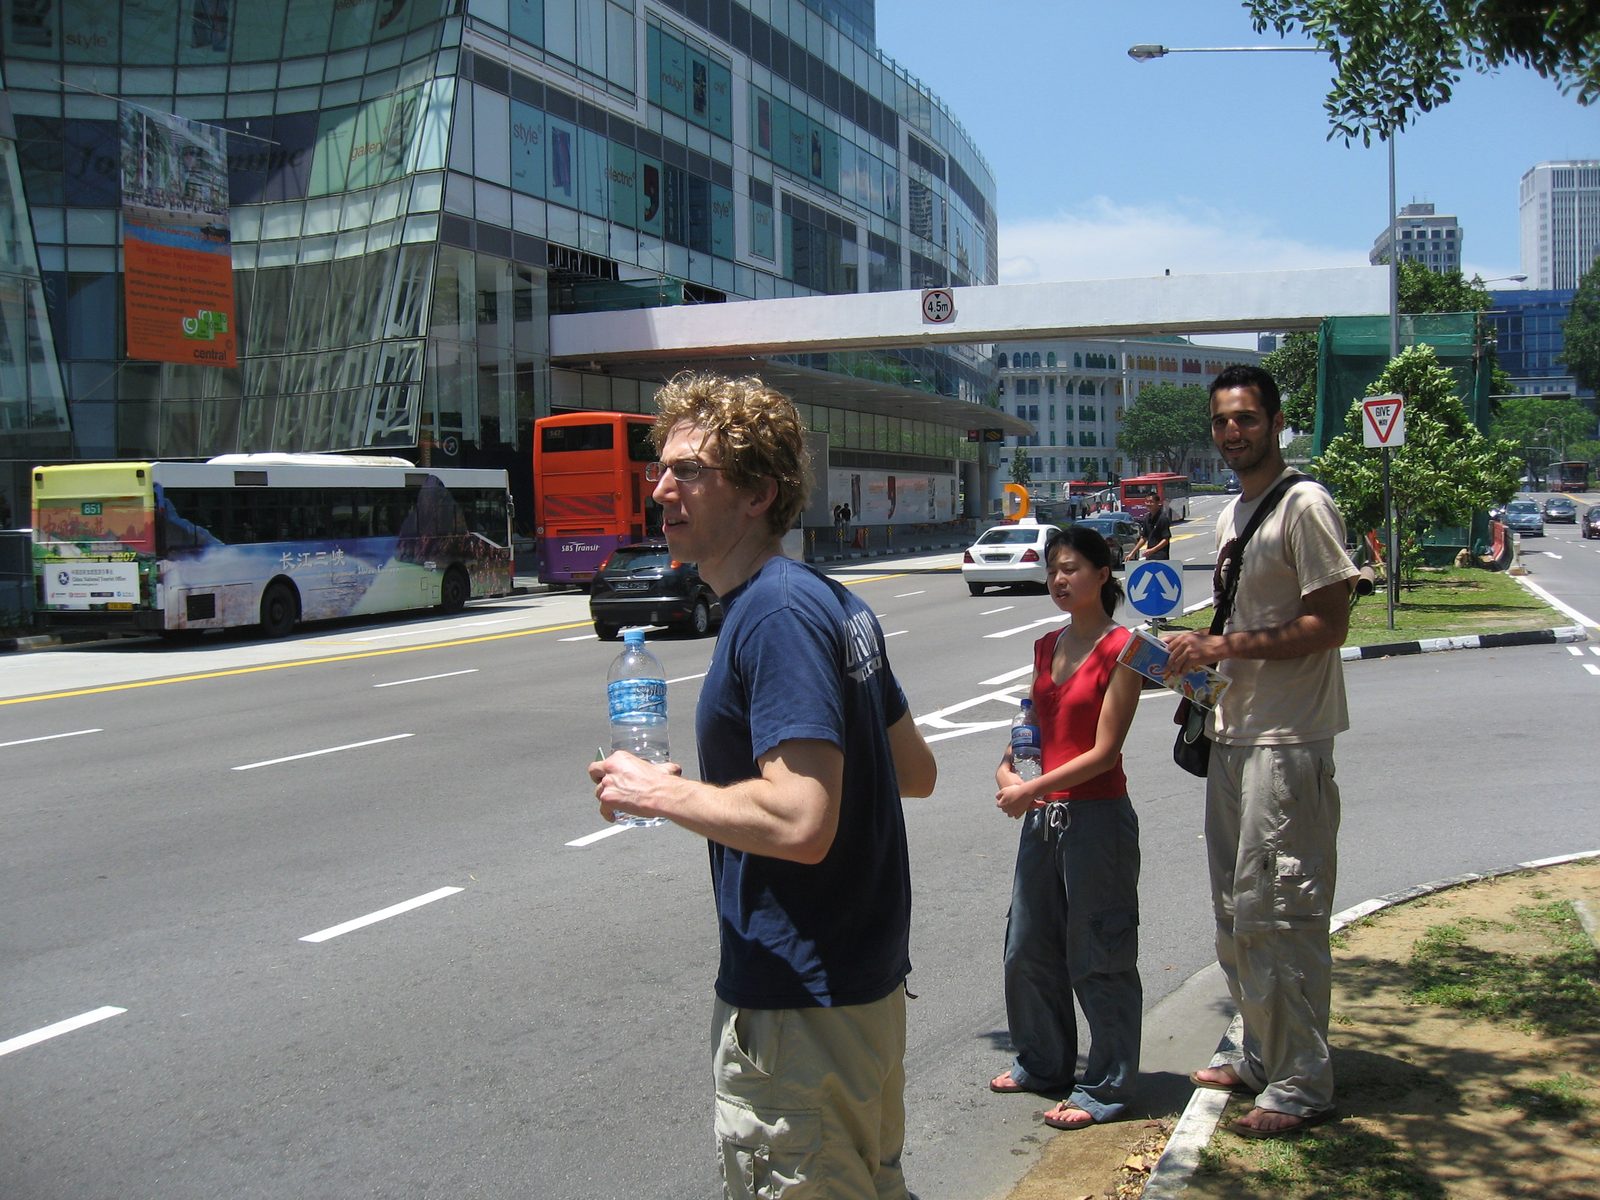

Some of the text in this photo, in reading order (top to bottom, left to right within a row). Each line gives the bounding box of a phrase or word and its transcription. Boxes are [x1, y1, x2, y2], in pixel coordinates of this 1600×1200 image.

[65, 32, 108, 50] style
[512, 123, 539, 146] style
[712, 201, 729, 219] style
[928, 301, 948, 313] 4.5m
[193, 348, 227, 361] central
[1376, 406, 1390, 417] GIVE
[84, 503, 101, 514] 851
[574, 542, 600, 553] Transit
[279, 549, 347, 570] 长江三峡
